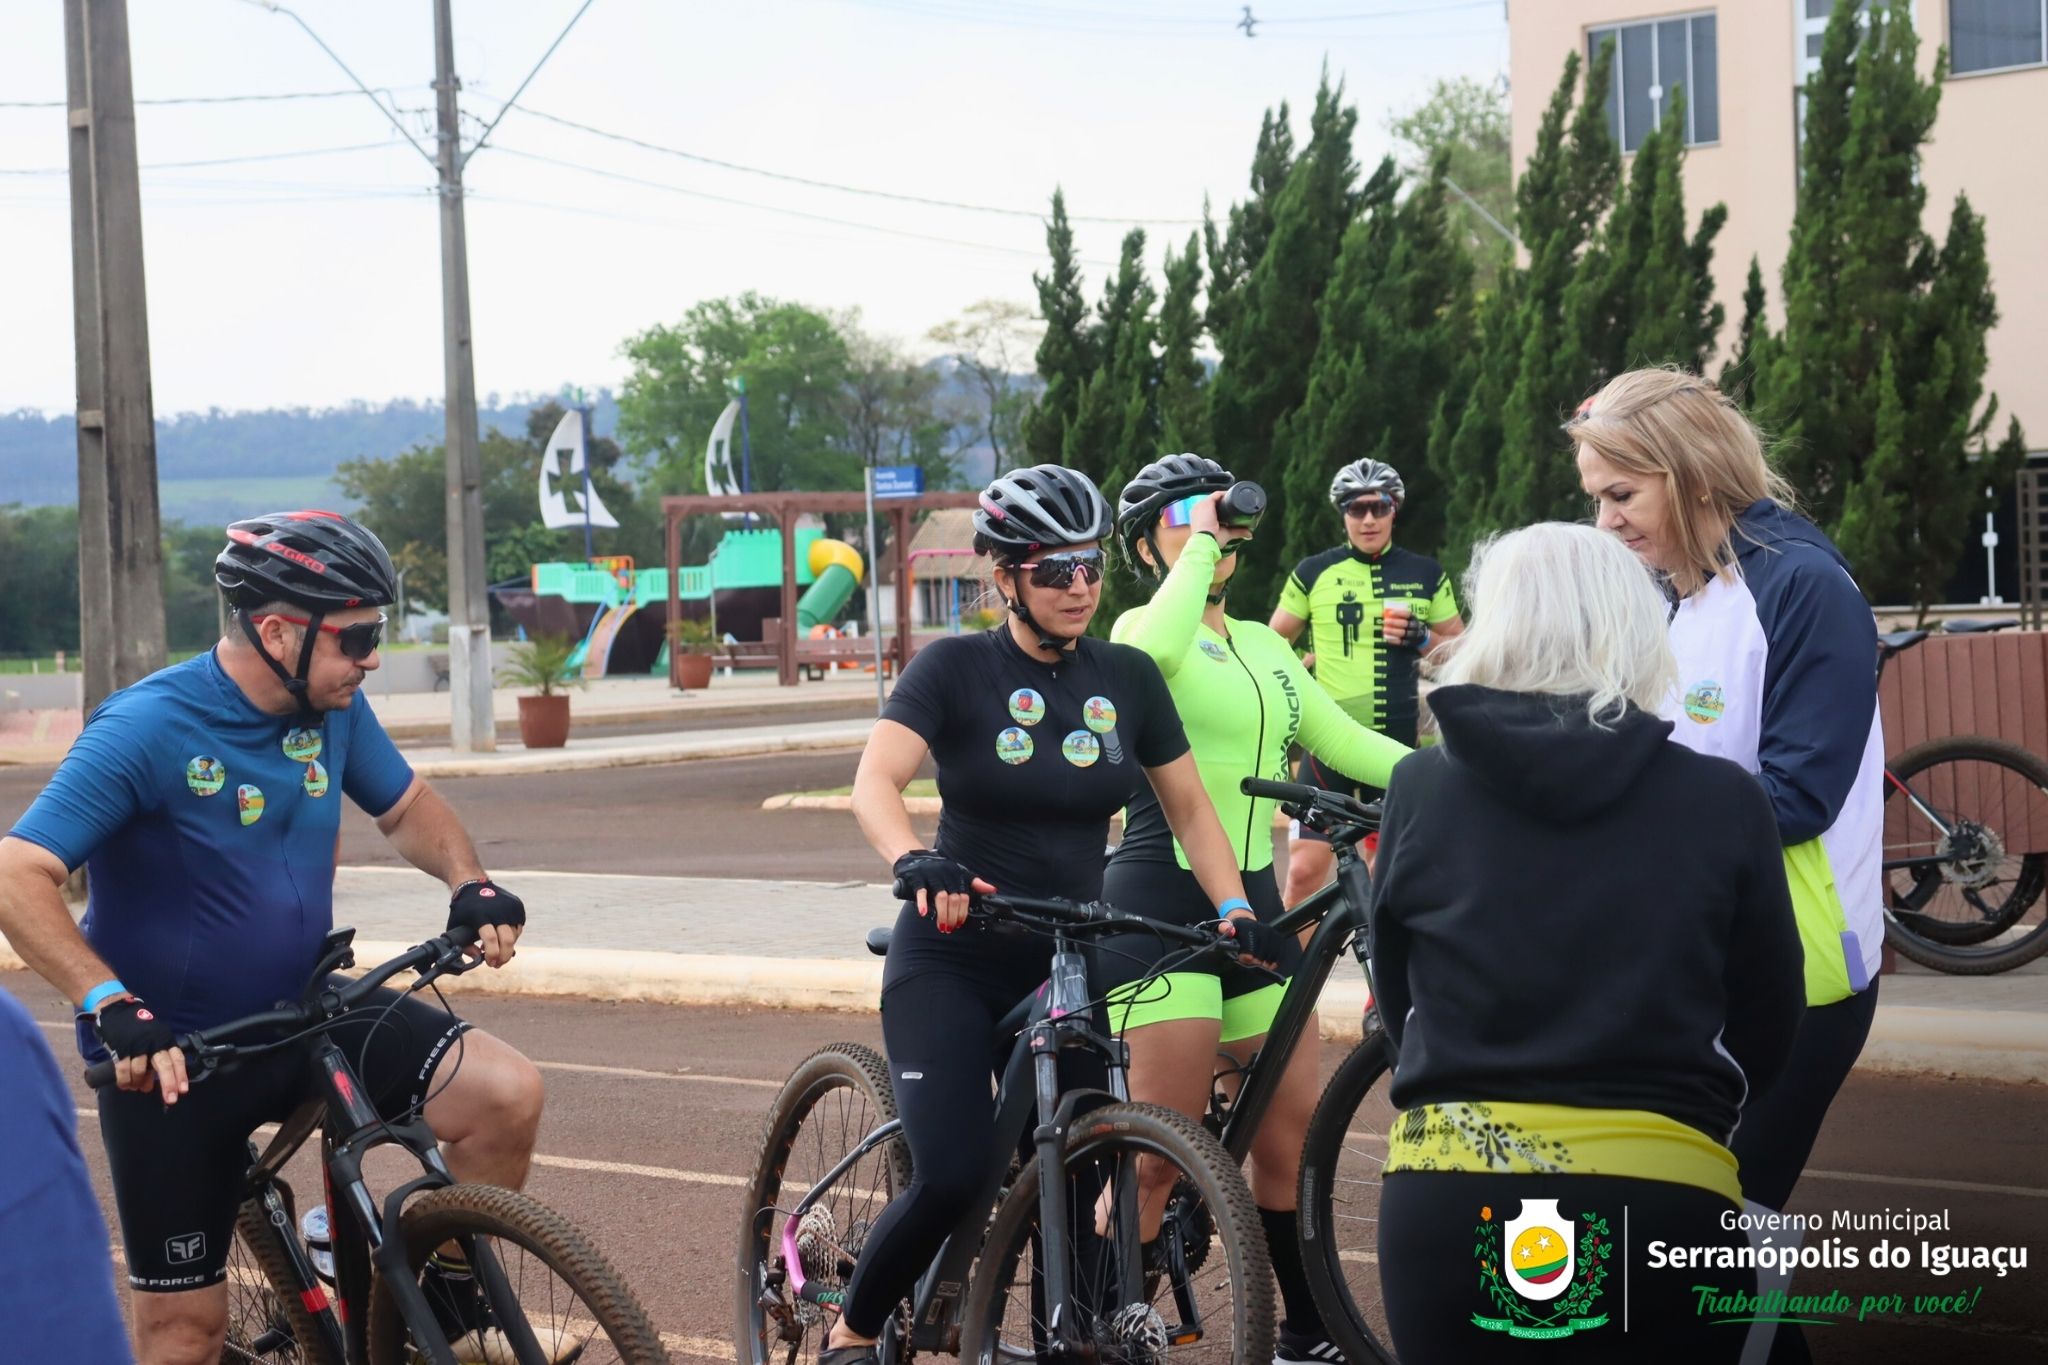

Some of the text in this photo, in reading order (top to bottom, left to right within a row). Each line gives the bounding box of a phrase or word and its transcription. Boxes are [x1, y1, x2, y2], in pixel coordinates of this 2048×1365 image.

[283, 548, 326, 575] GIRO
[418, 1037, 448, 1081] FREE
[149, 1274, 205, 1286] FORCE
